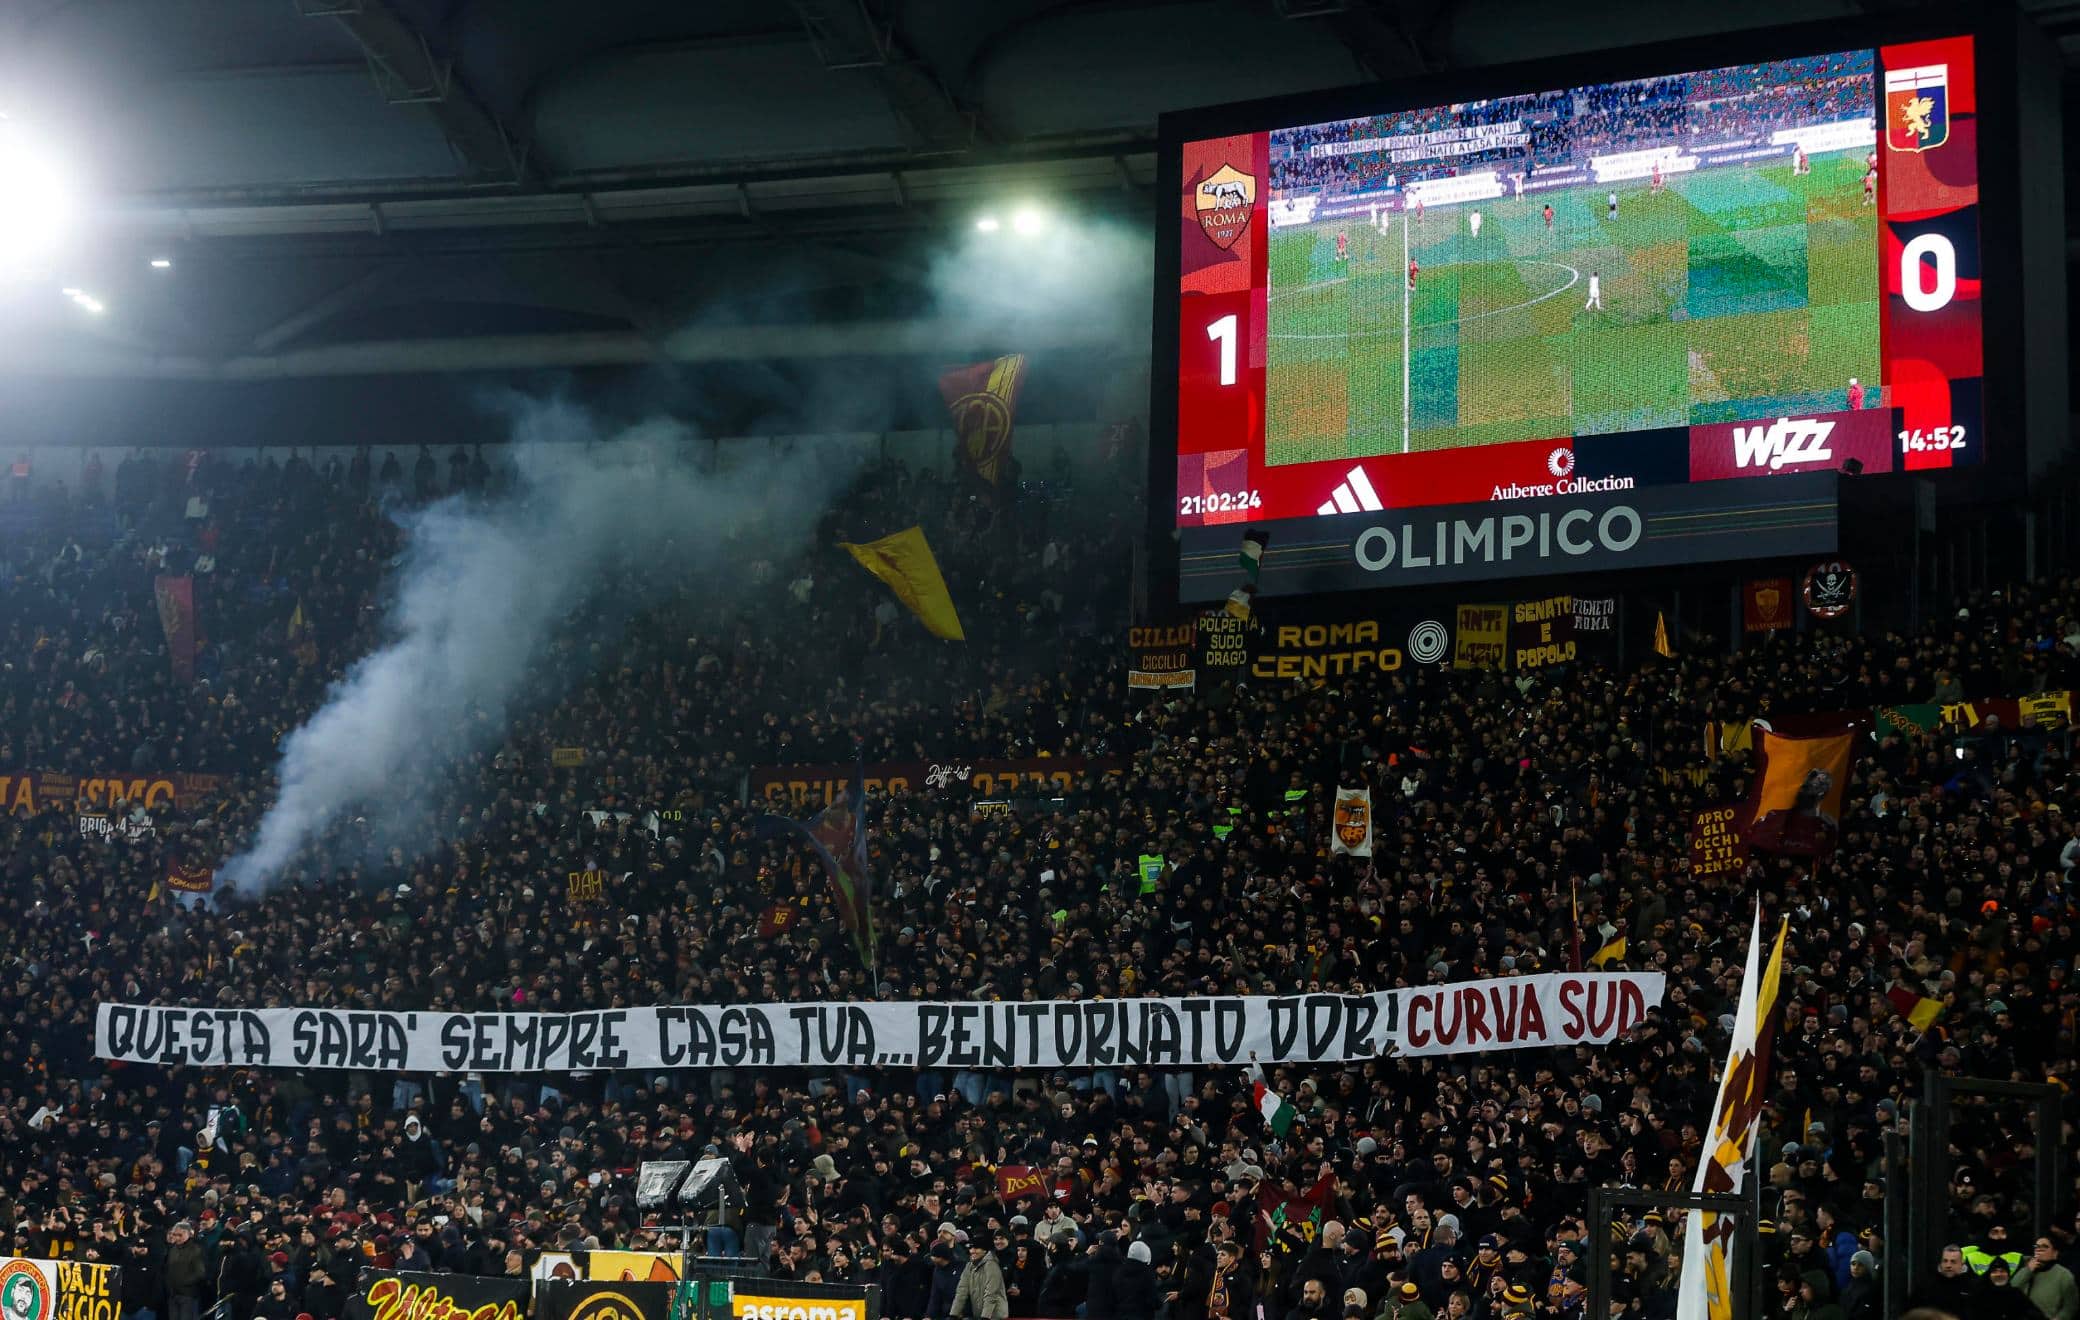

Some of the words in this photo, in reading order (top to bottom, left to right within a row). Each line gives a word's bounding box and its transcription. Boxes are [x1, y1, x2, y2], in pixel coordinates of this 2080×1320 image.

[1205, 213, 1247, 228] ROMA
[1901, 232, 1956, 313] 0
[1206, 314, 1238, 386] 1
[1897, 425, 1967, 453] 14:52
[1490, 481, 1554, 501] Auberge
[1556, 474, 1634, 496] Collection
[1180, 489, 1262, 516] 21:02:24
[1354, 506, 1642, 572] OLIMPICO
[1515, 595, 1573, 624] SENATO
[1200, 616, 1259, 633] POLPETA
[1278, 620, 1380, 648] ROMA
[1541, 623, 1552, 643] E
[1573, 616, 1610, 631] ROMA
[1210, 634, 1244, 650] SUDO
[1516, 640, 1577, 669] POPOLO
[1206, 650, 1247, 666] DRAGO
[1697, 808, 1735, 825] APRO
[1703, 823, 1726, 837] GLI
[1694, 833, 1740, 850] OCCHI
[1704, 849, 1714, 861] E
[1717, 846, 1733, 860] TI
[108, 1005, 271, 1064] QUESTA
[292, 1012, 417, 1069] SARA'
[441, 1011, 629, 1071] SEMPRE
[655, 1006, 776, 1066] CASA
[790, 1005, 912, 1066] TUA...
[917, 1001, 1246, 1066] BENTORNATO
[1406, 979, 1548, 1048] CURVA
[1557, 976, 1645, 1042] SUD
[56, 1261, 112, 1297] DAJE
